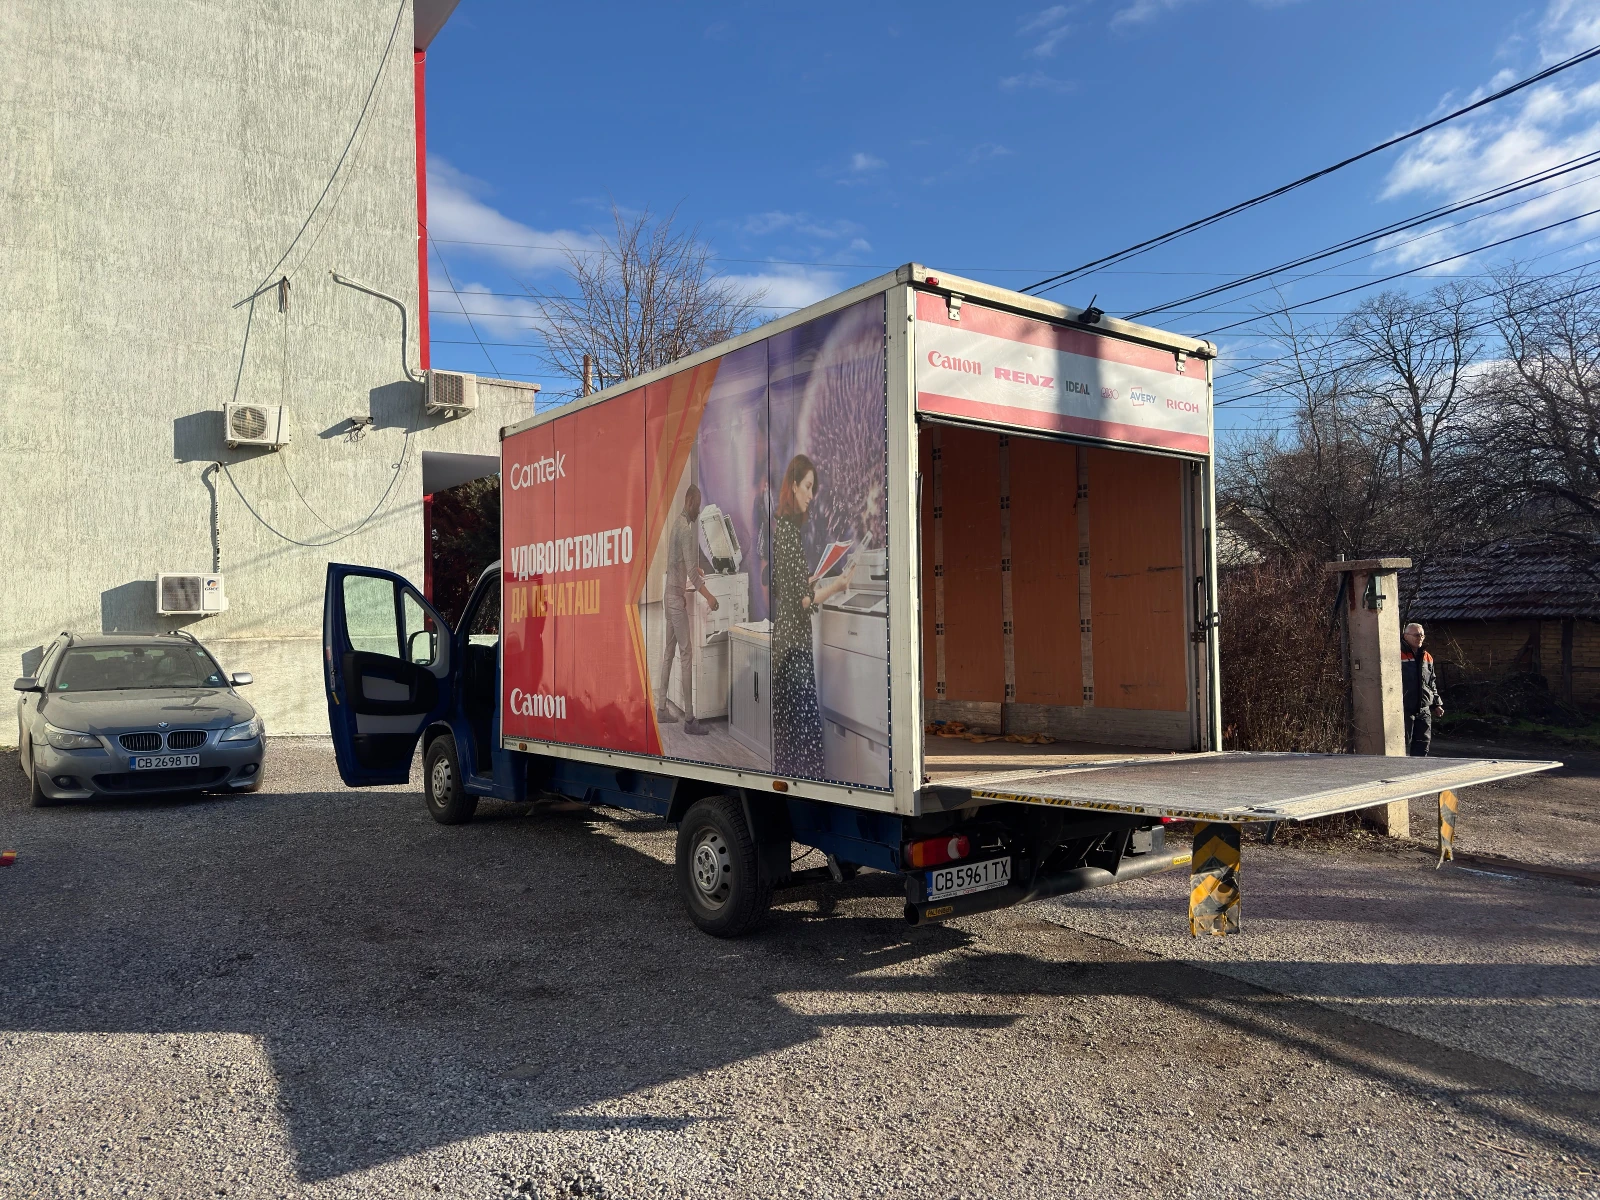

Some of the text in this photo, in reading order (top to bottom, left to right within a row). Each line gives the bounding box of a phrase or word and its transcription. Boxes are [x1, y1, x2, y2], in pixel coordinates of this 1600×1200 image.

[928, 351, 1199, 413] Canon RENZ IDEAL RISO AVERY RICOH
[510, 450, 566, 491] Cantek
[511, 525, 633, 582] УДОВОЛСТВИЕТО
[511, 579, 600, 623] ДА ПЕЧАТАШ
[510, 688, 567, 719] Canon
[137, 758, 152, 768] CB
[155, 756, 181, 767] 2698
[935, 871, 954, 891] CB
[956, 863, 988, 888] 5961
[992, 859, 1008, 880] TX
